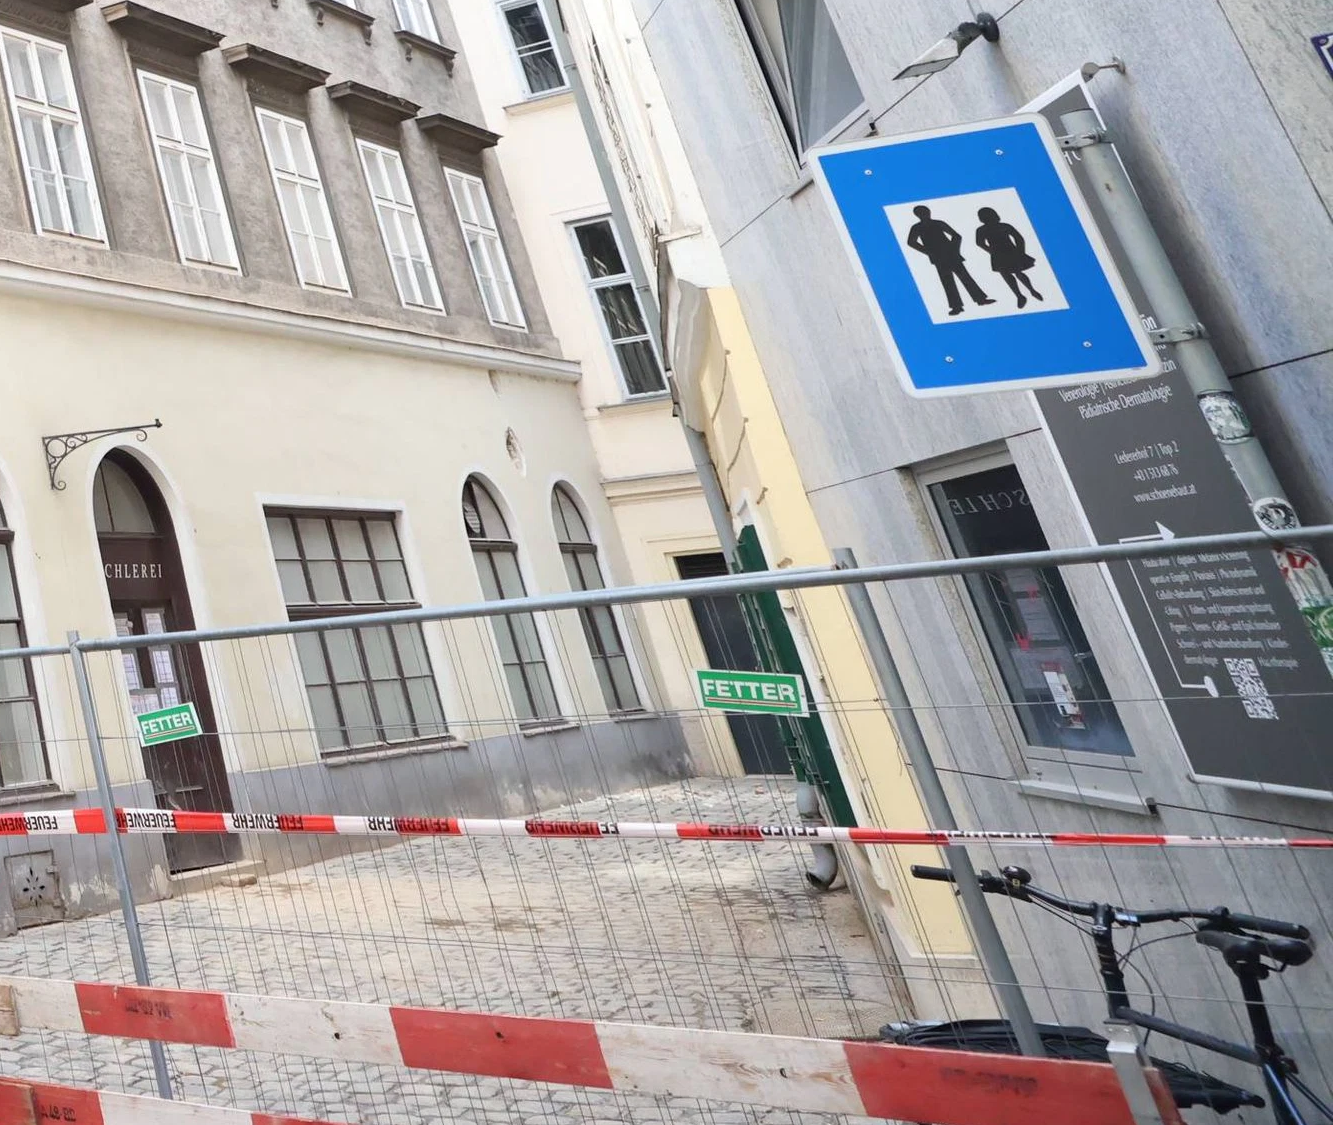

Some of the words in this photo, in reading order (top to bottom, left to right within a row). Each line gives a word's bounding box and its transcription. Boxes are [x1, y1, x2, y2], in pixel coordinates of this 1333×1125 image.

[1118, 382, 1173, 409] Dermatologie
[701, 678, 796, 702] FETTER
[141, 711, 193, 734] FETTER
[231, 813, 304, 831] FEUERWEHR
